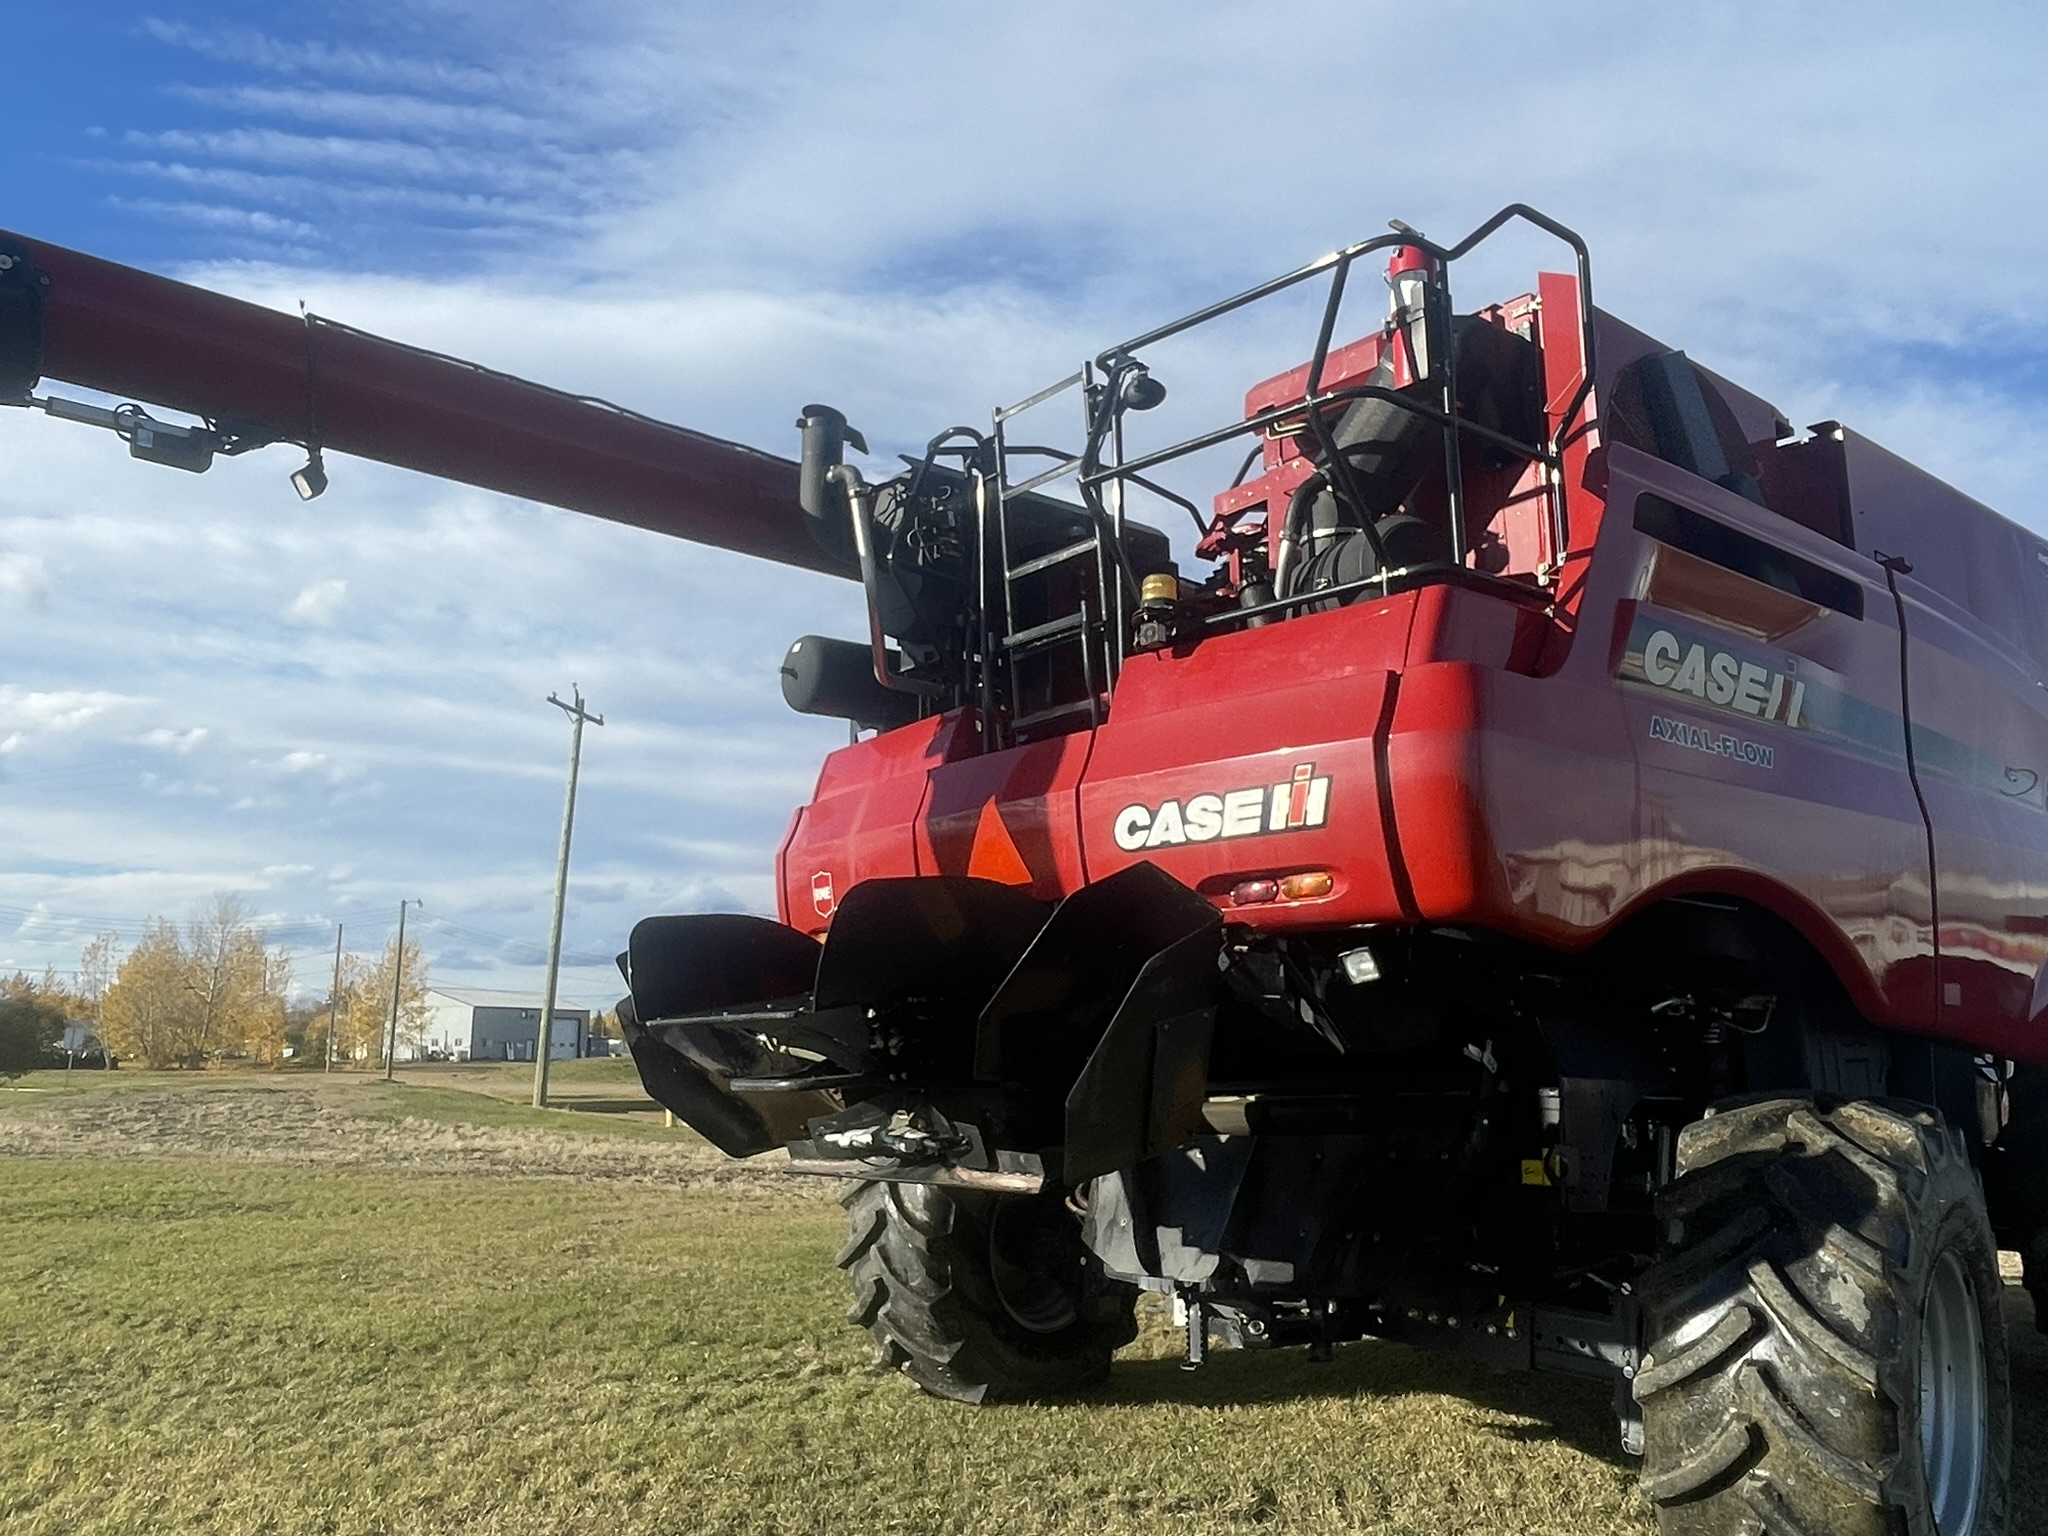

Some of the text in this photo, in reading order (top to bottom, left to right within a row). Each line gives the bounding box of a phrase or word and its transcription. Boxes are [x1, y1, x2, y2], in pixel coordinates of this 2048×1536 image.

[1644, 630, 1768, 715] CASE
[1650, 715, 1774, 769] AXIAL-FLOW
[1114, 787, 1264, 850] CASE
